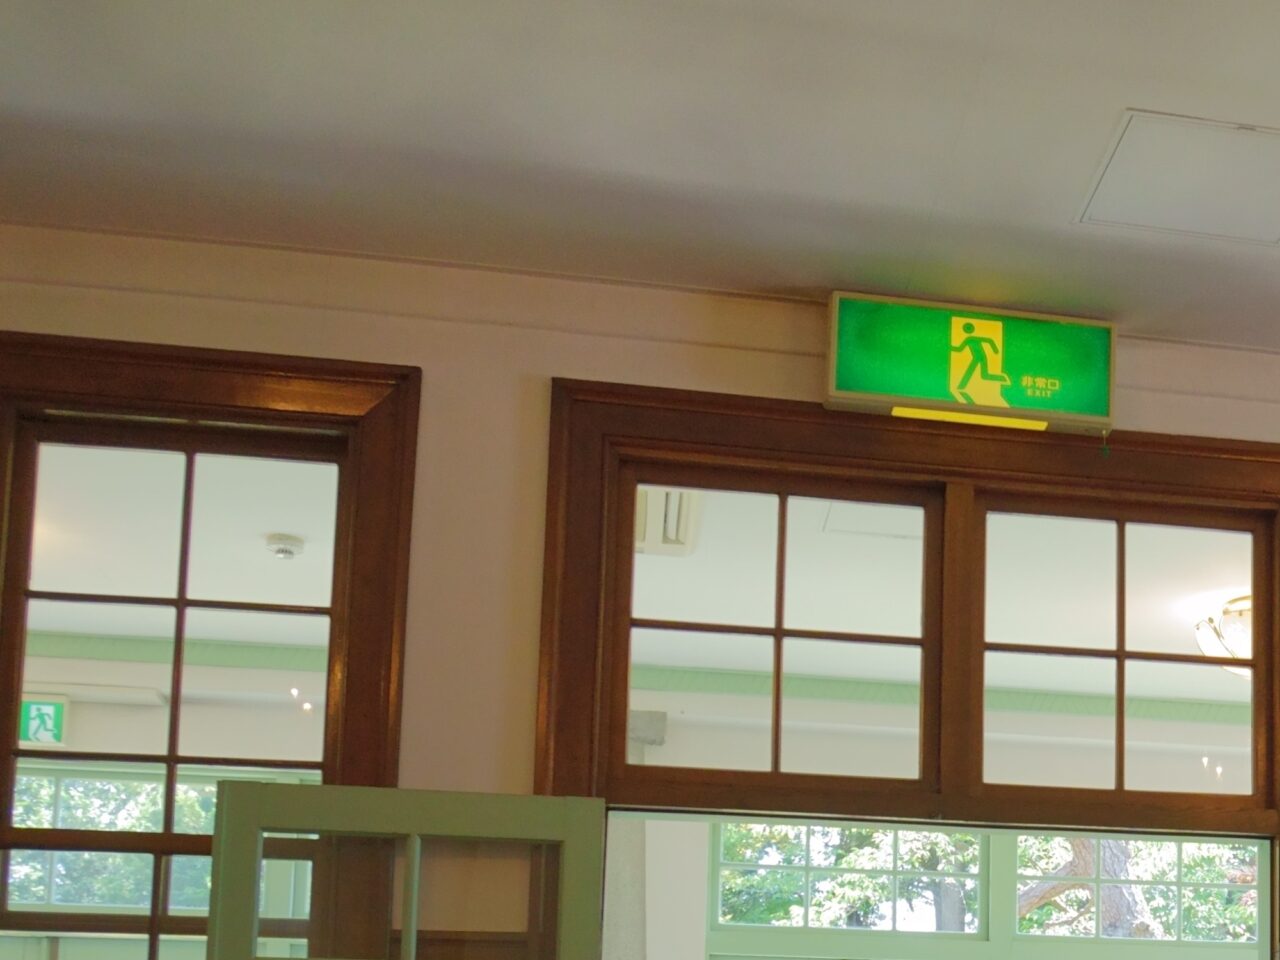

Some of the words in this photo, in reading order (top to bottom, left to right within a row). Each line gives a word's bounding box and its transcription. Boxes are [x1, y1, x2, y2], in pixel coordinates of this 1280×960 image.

[1022, 376, 1060, 390] 非常口
[1027, 389, 1052, 398] EXIT
